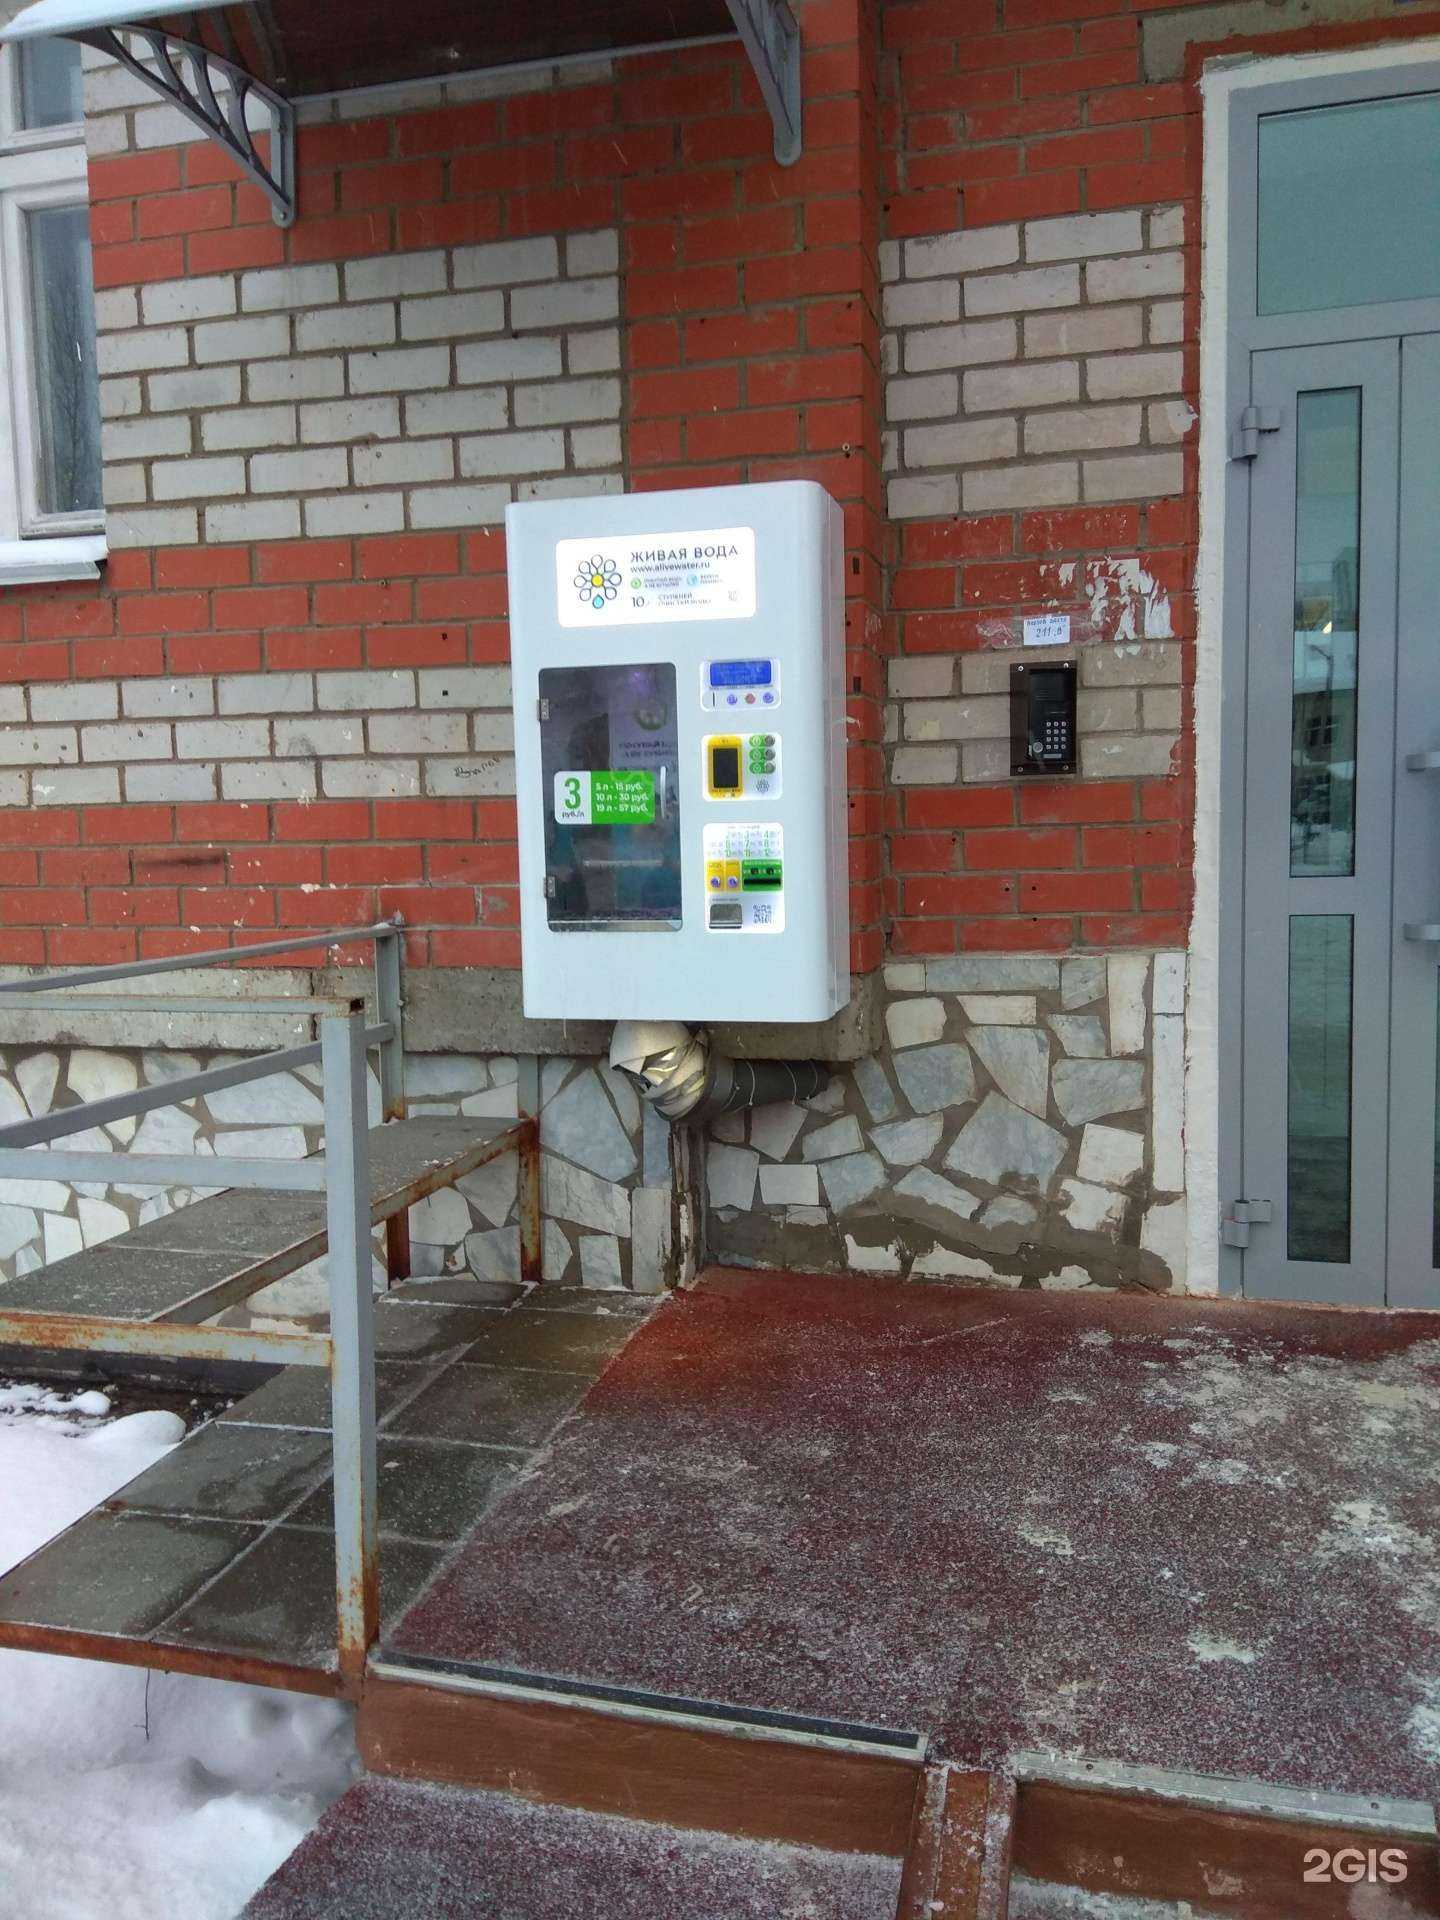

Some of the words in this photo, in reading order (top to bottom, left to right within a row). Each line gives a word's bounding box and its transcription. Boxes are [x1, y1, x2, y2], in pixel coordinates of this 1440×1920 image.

[630, 548, 687, 563] ЖИВАЯ
[694, 545, 738, 559] ВОДА
[630, 561, 710, 573] www.alivewater.ru
[632, 596, 645, 607] 10
[564, 777, 581, 810] 3
[595, 793, 605, 801] 10
[619, 793, 630, 801] 30
[619, 803, 629, 812] 57
